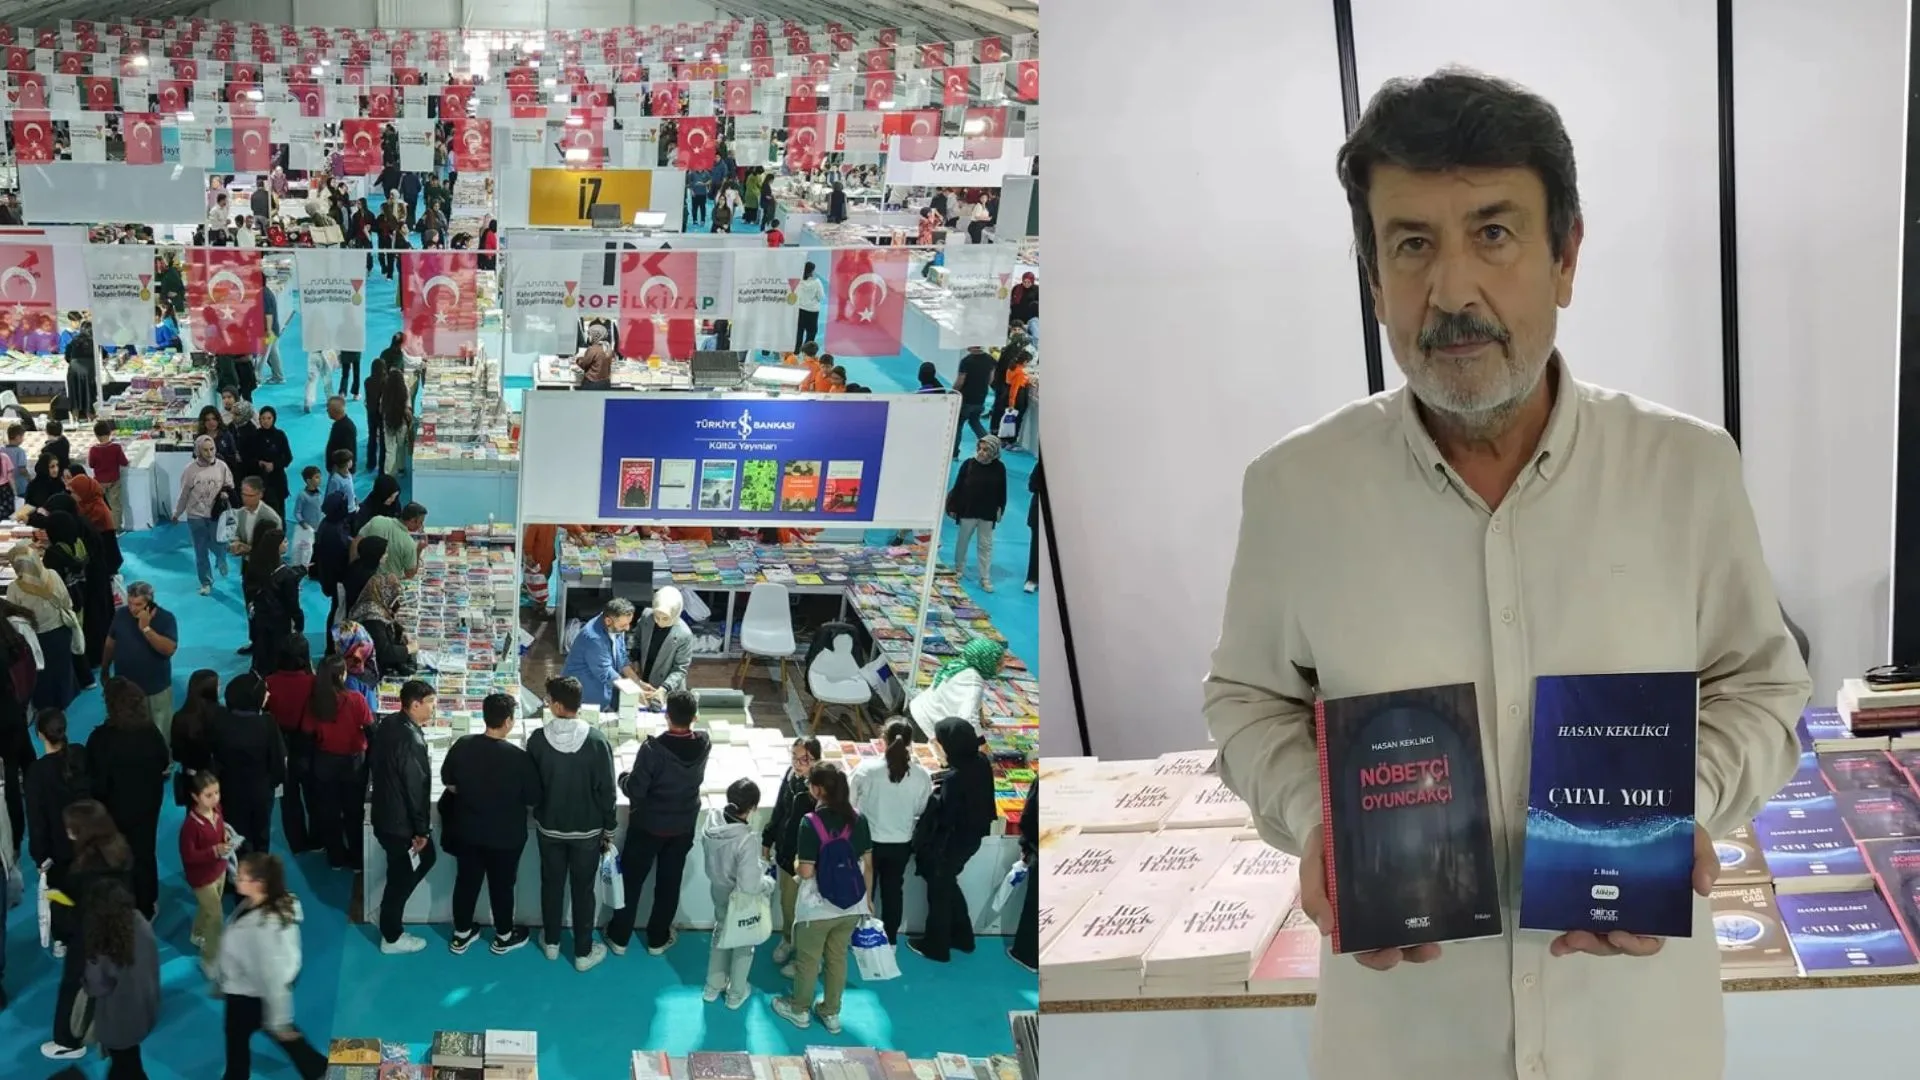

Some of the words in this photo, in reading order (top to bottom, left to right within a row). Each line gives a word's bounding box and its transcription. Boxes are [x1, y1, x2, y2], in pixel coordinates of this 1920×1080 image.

[949, 151, 974, 160] NAR
[930, 162, 990, 173] YAYINLARI
[696, 419, 737, 430] TÜRKİYE
[753, 421, 796, 430] BANKASI
[709, 441, 737, 450] Kültür
[739, 442, 777, 452] Yayınları
[1558, 725, 1603, 736] HASAN
[1606, 723, 1670, 737] KEKLİKCİ
[1371, 741, 1398, 751] HASAN
[1360, 753, 1450, 788] NÖBETÇİ
[1549, 787, 1610, 808] ÇATAL
[1620, 788, 1672, 806] YOLU
